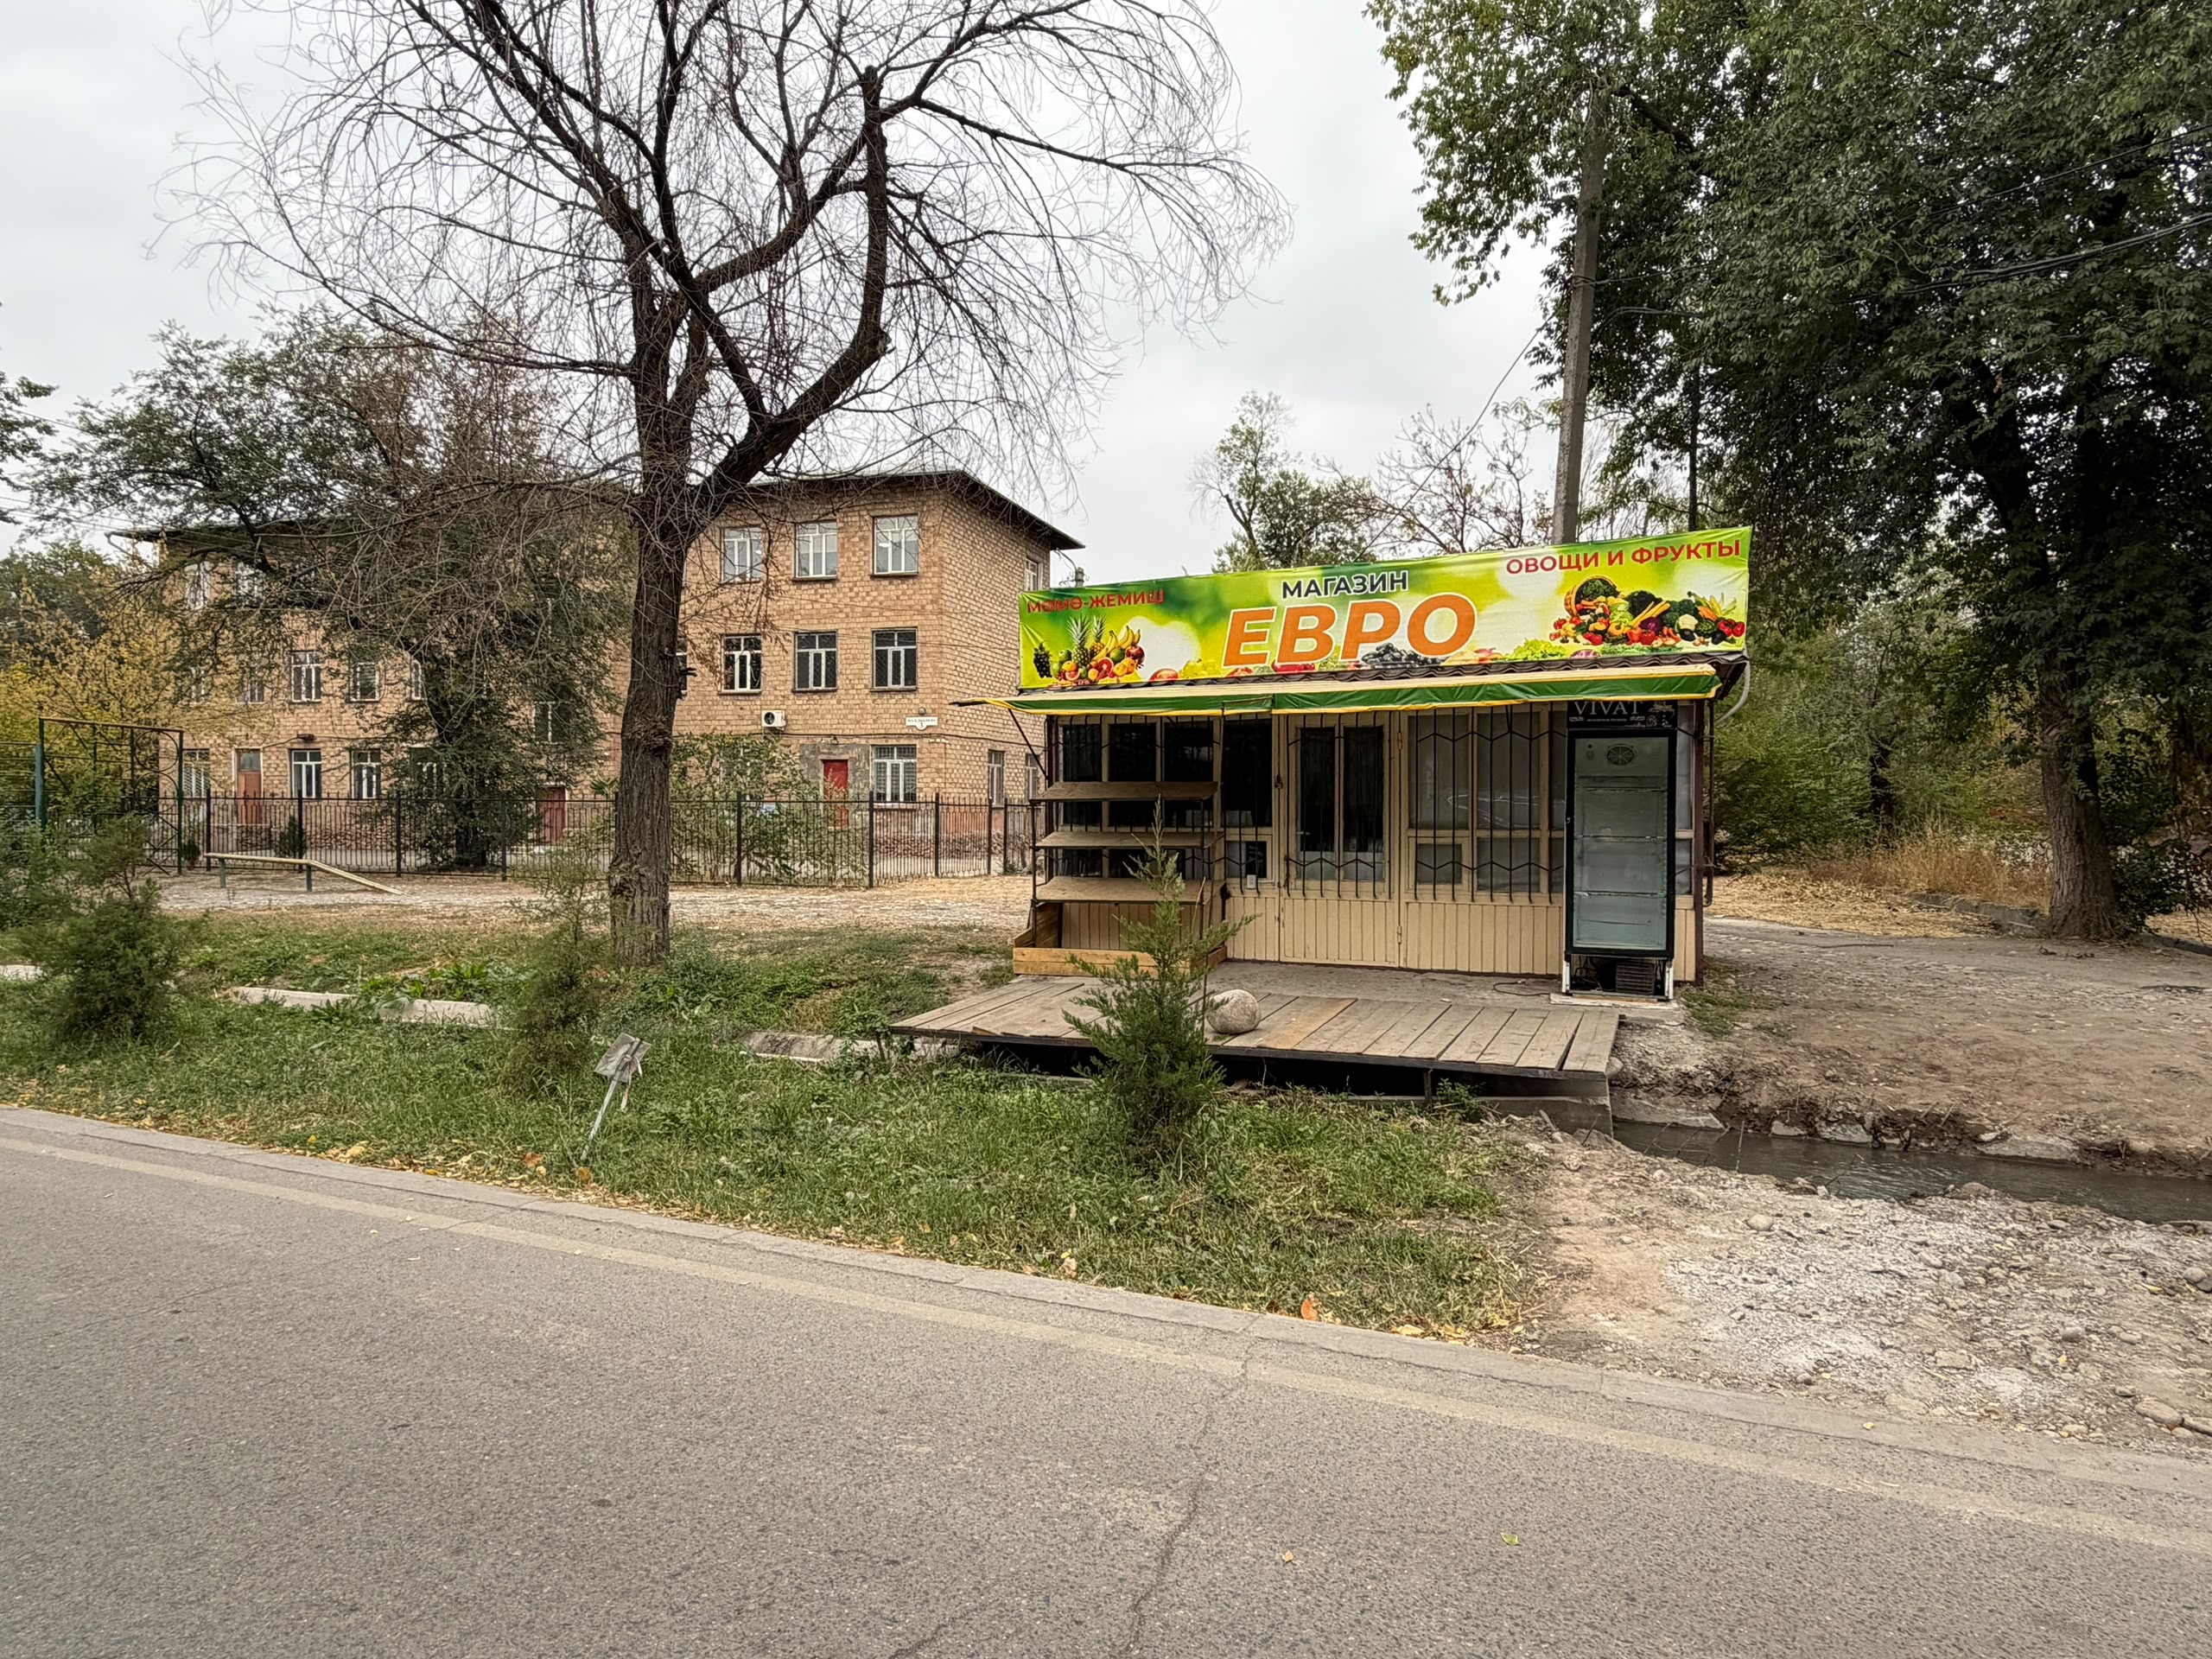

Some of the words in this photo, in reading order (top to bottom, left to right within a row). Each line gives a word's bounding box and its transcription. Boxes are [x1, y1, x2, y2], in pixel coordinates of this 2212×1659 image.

[1506, 551, 1599, 575] ОВОЩИ
[1607, 550, 1624, 567] И
[1631, 539, 1741, 563] ФРУКТЫ
[1282, 570, 1408, 599] МАГАЗИН
[1223, 592, 1477, 667] ЕВРО
[1573, 701, 1643, 715] VIVAT
